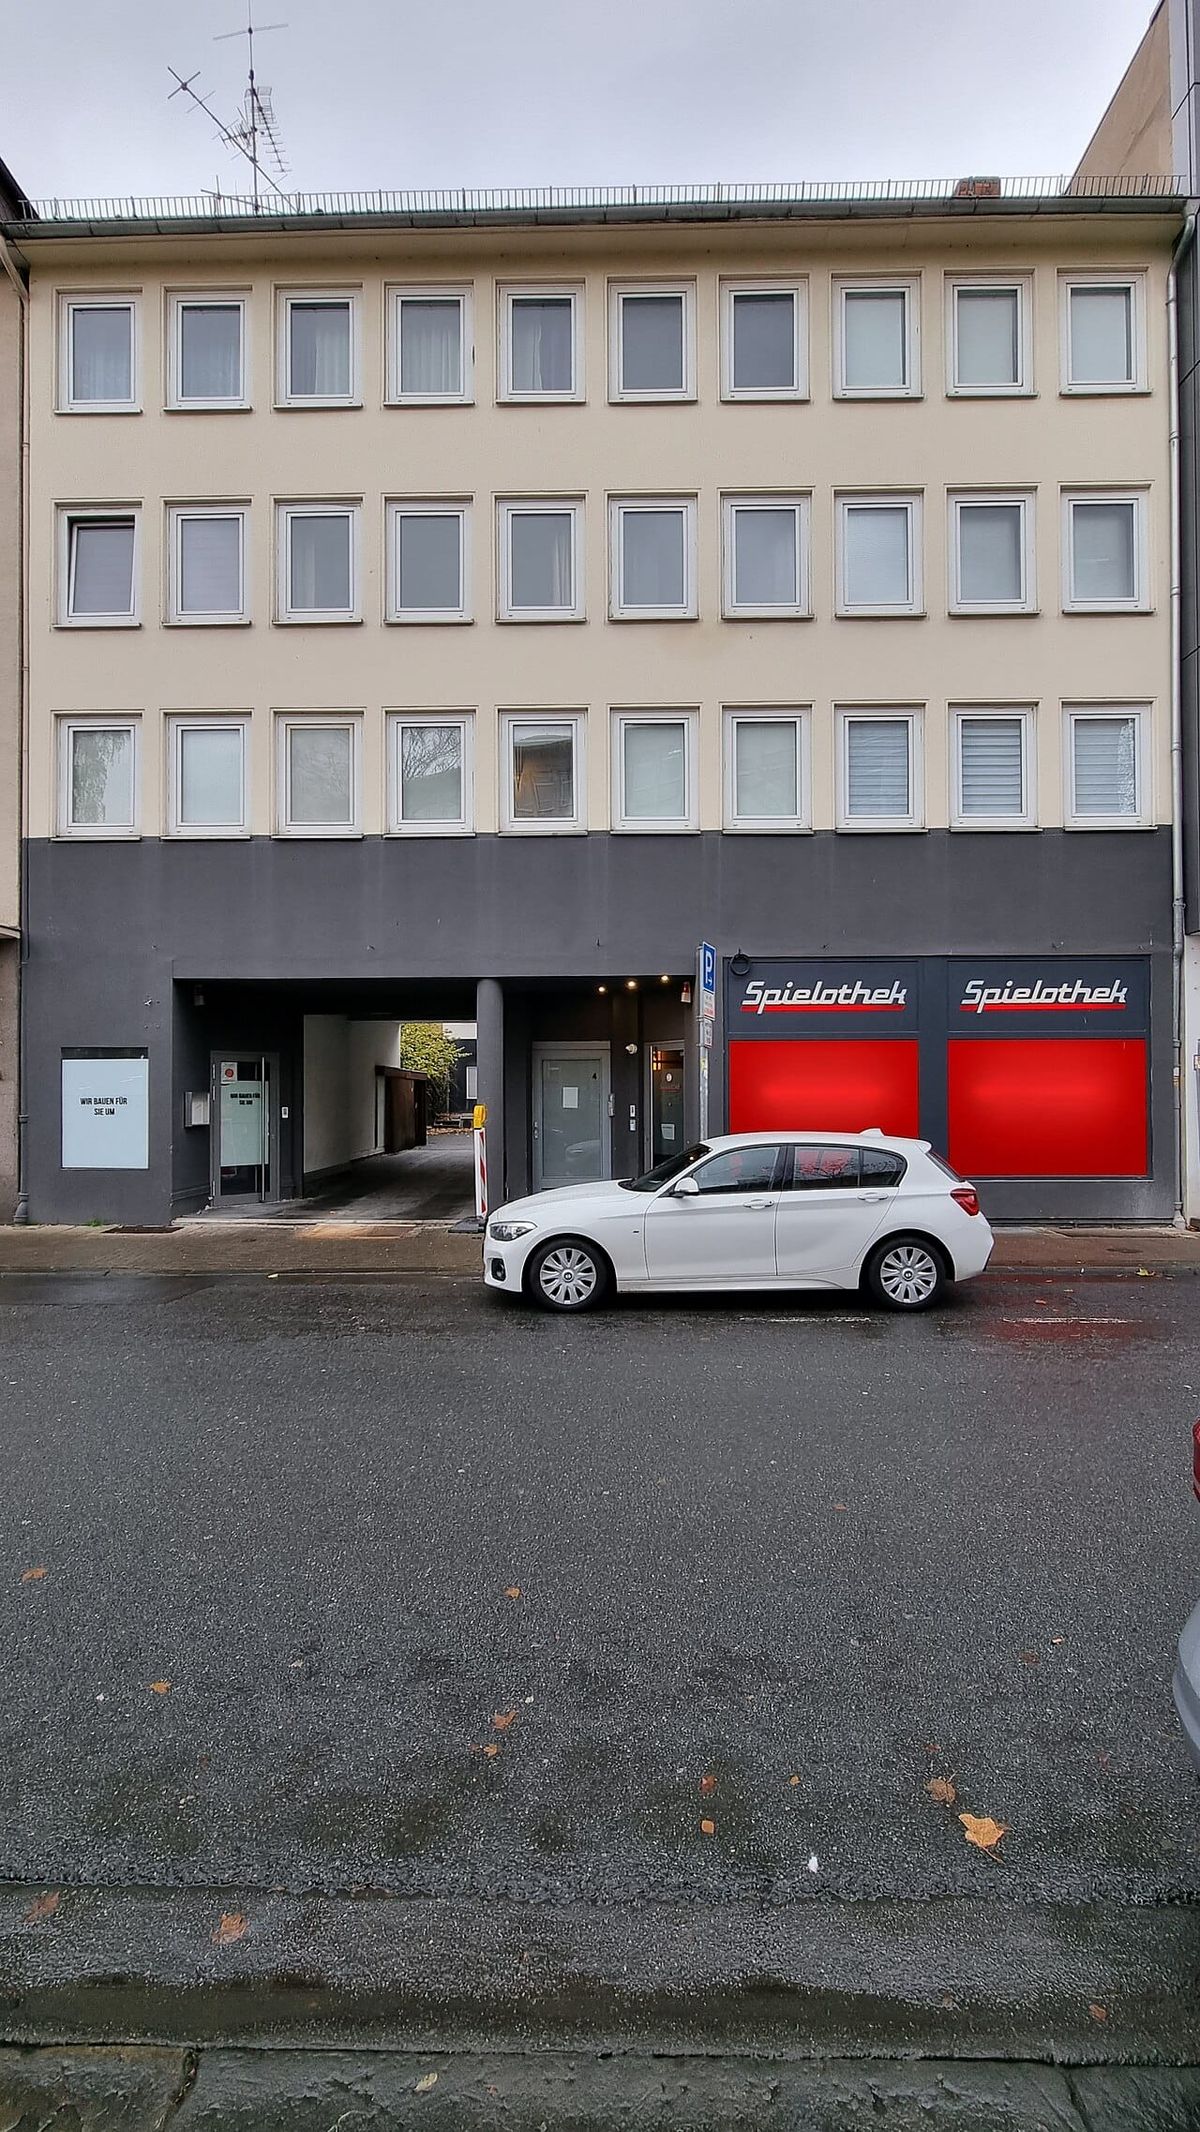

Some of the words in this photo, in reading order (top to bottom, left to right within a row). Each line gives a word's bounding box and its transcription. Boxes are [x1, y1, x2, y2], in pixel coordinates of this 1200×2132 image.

[705, 950, 713, 984] P
[742, 981, 907, 1014] Spielothek
[961, 979, 1128, 1013] Spielothek
[80, 1097, 93, 1105] WIR
[93, 1097, 114, 1105] BAUEN
[115, 1096, 128, 1105] FÜR
[94, 1108, 104, 1116] SIE
[105, 1108, 115, 1116] UM
